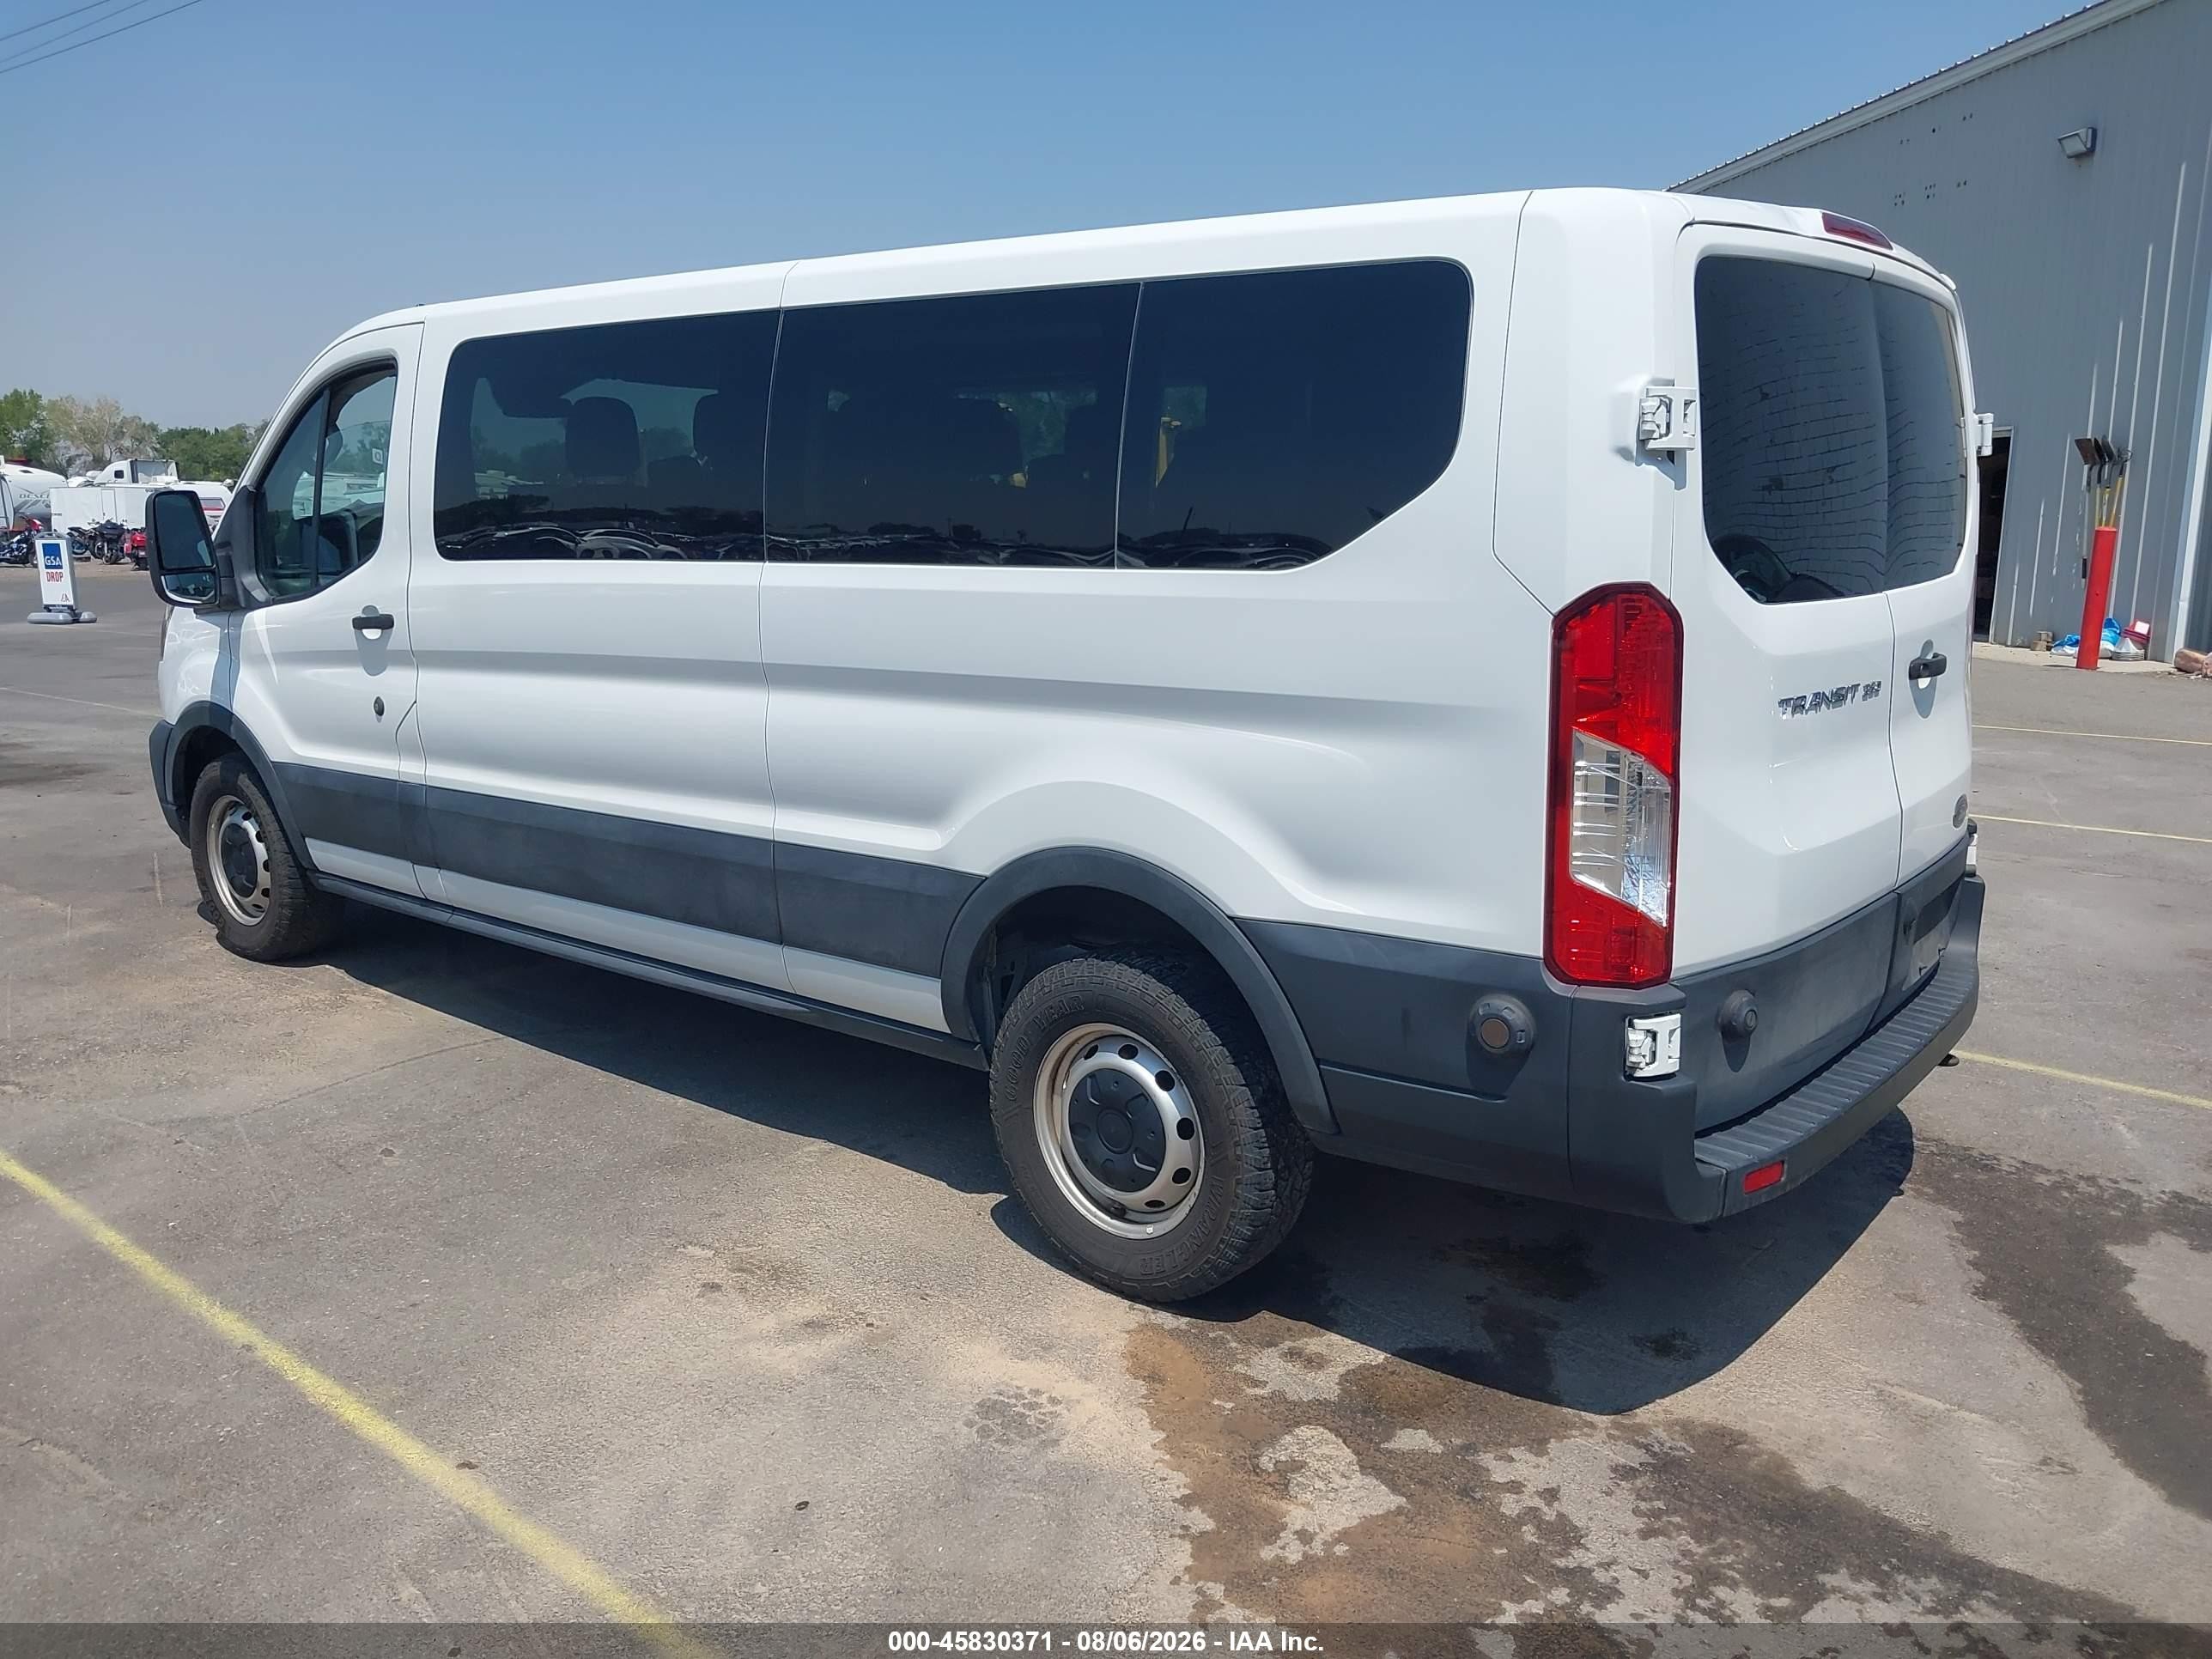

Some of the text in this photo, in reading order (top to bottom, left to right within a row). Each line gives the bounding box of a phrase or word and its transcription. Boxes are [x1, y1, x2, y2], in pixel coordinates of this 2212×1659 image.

[45, 556, 62, 566] GSA
[46, 572, 64, 583] DROP
[1778, 684, 1861, 716] TRANSIT
